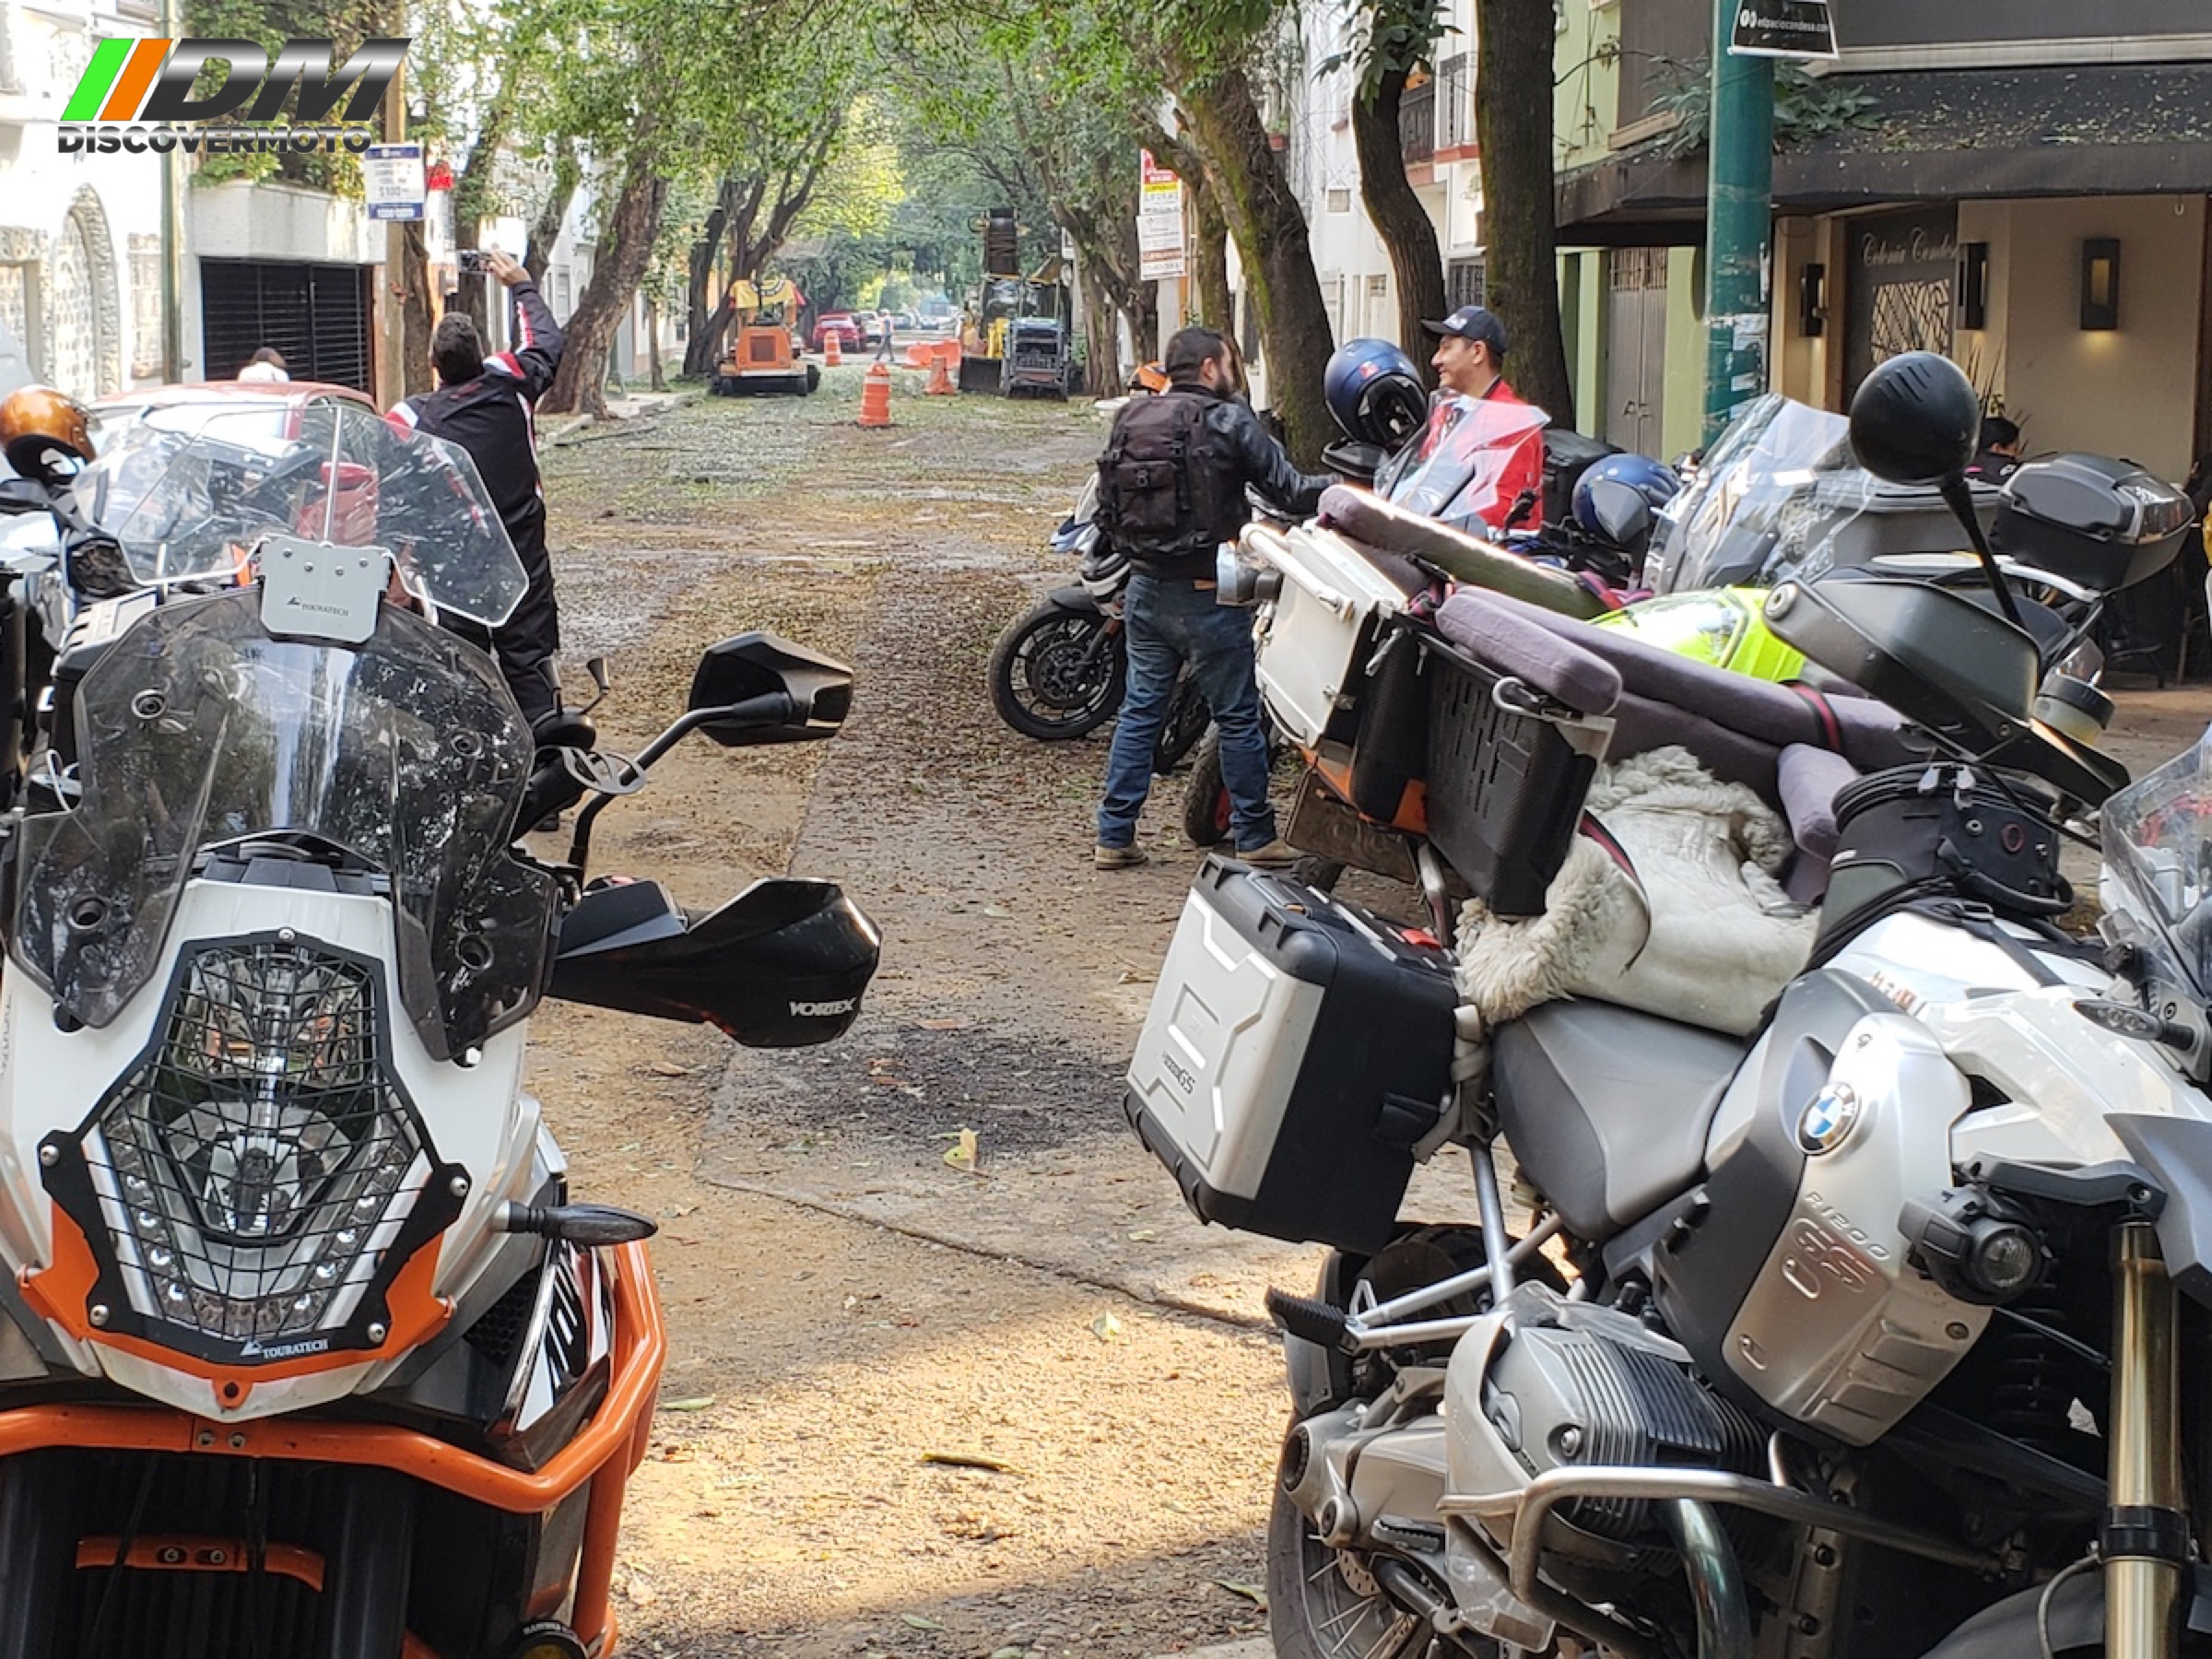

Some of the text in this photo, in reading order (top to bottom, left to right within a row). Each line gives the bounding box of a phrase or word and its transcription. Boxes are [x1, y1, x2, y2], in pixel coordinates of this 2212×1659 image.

[788, 996, 858, 1017] VORTEX
[1804, 1190, 1891, 1261] R1200
[263, 1338, 329, 1359] TOURATECH
